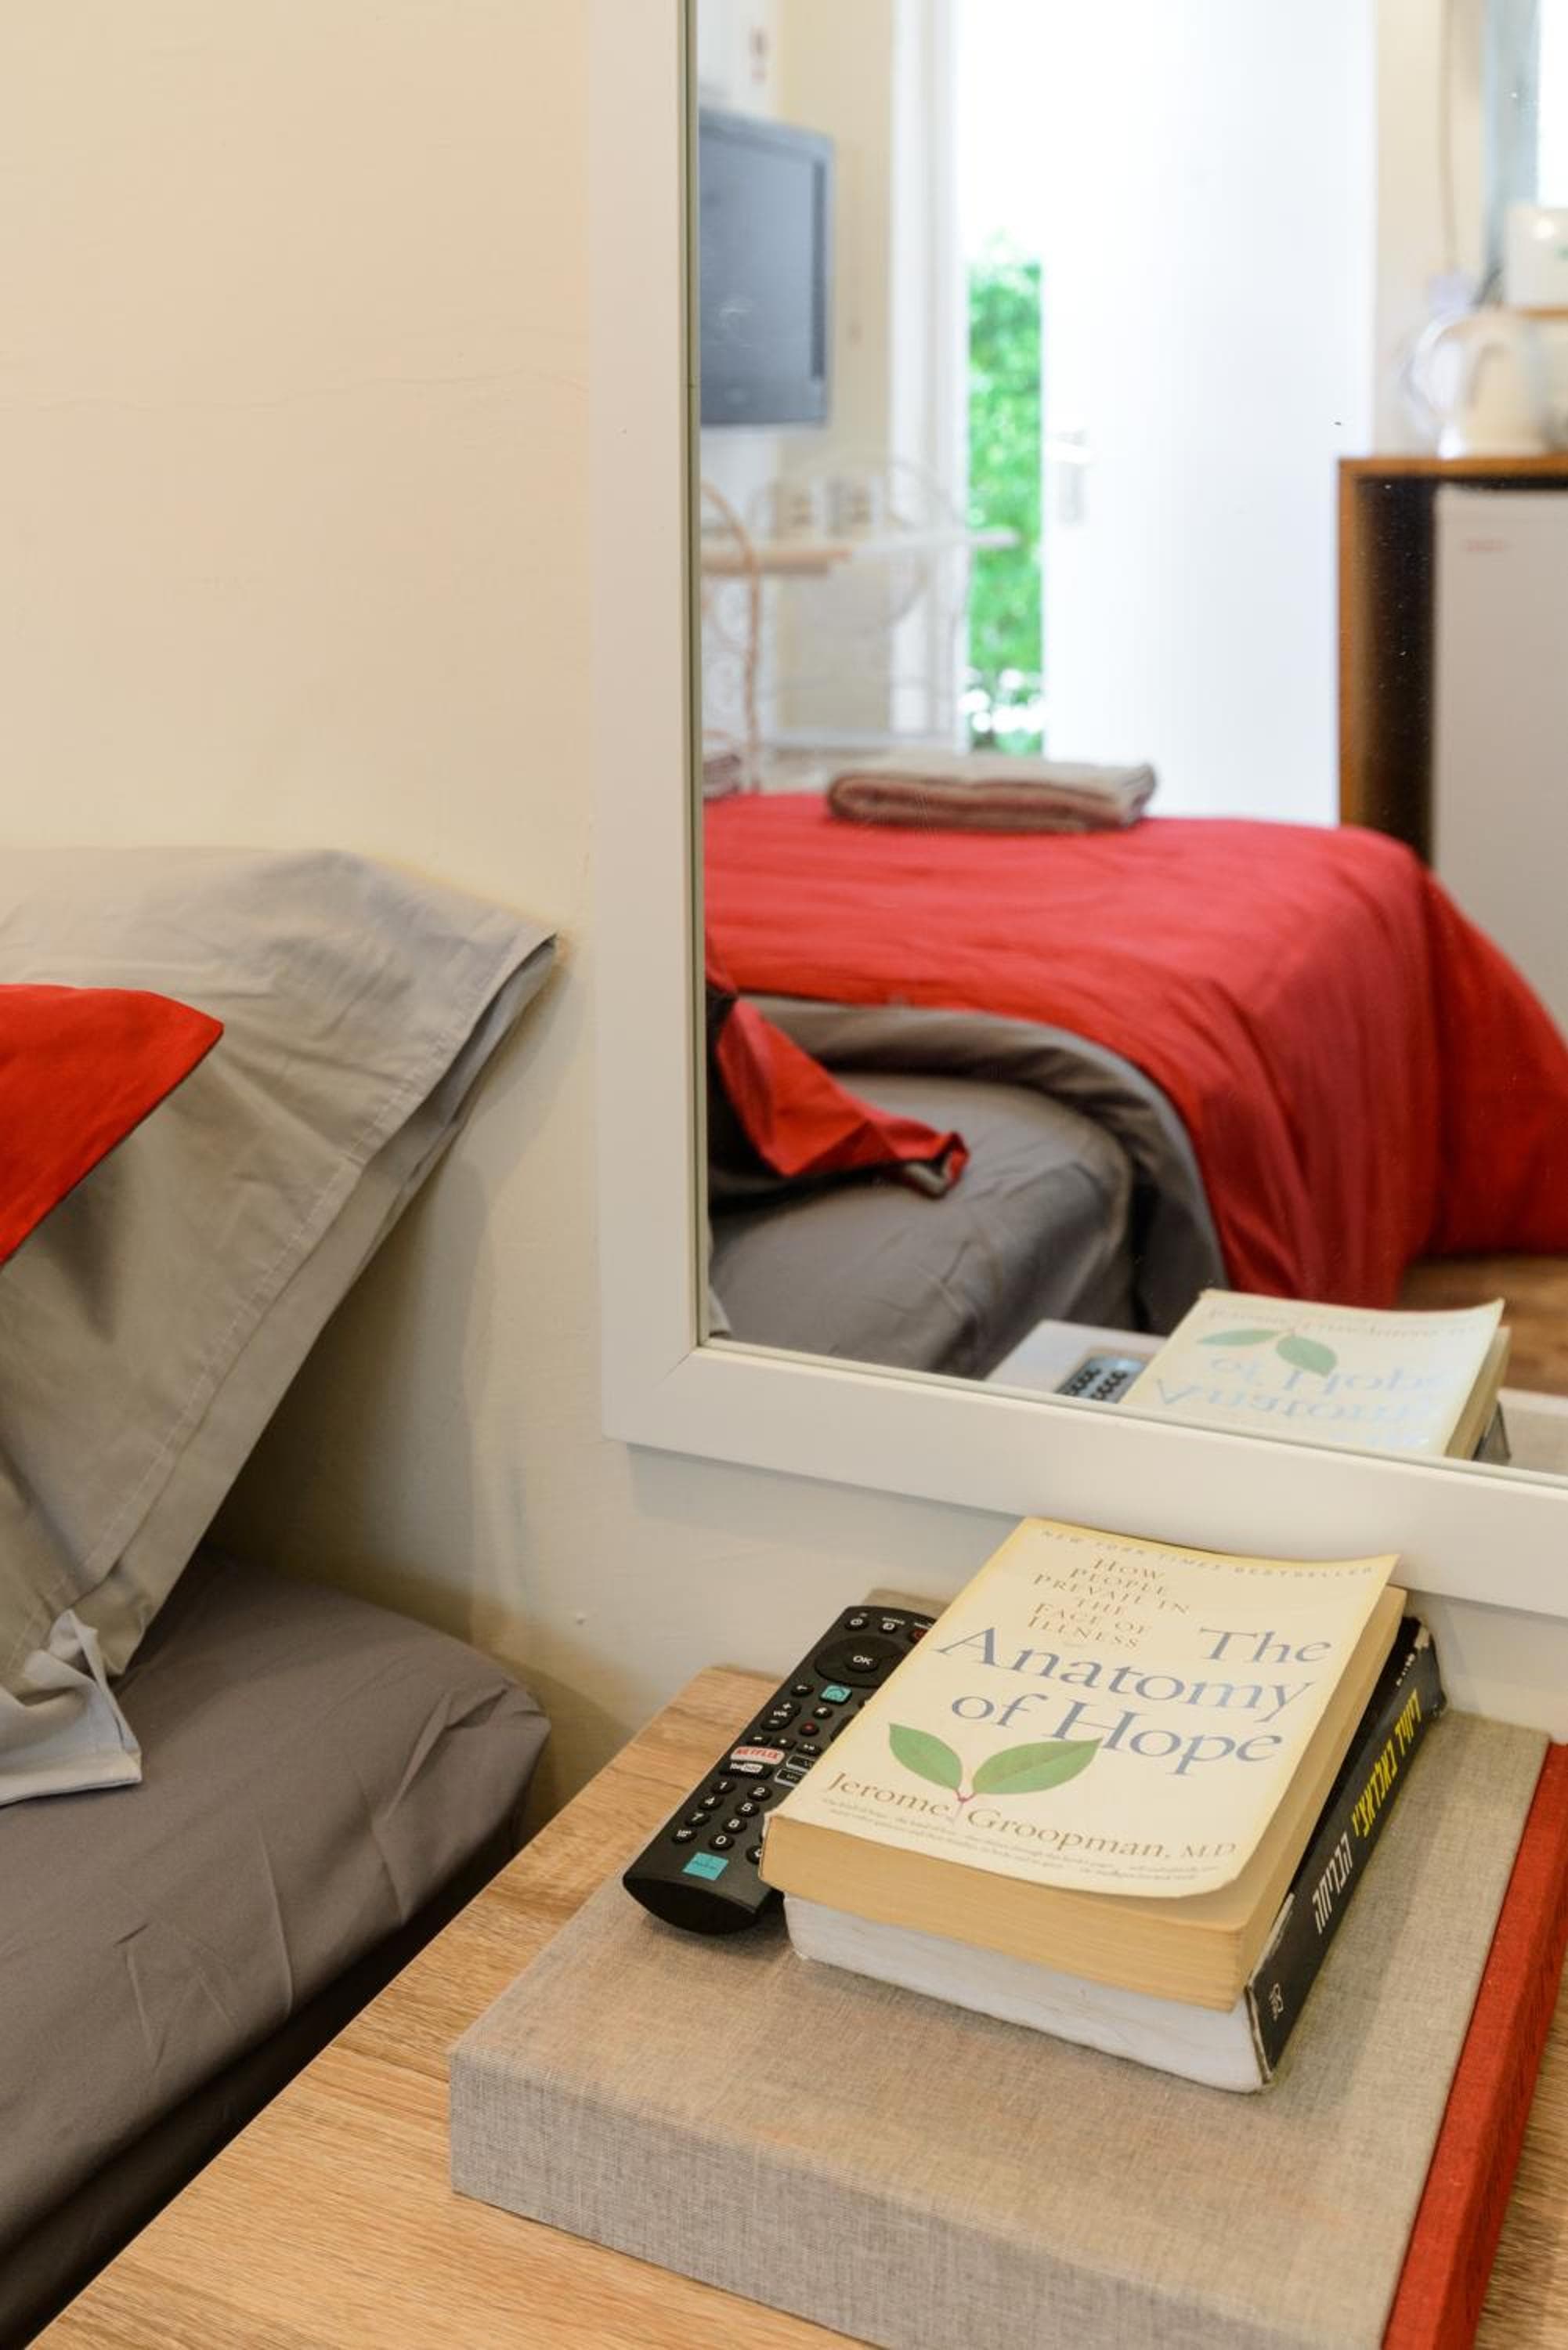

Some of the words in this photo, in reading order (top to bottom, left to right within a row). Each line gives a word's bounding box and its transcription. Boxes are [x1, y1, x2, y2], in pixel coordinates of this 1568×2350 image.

[1071, 1568, 1166, 1595] PEOPLE
[1093, 1559, 1165, 1579] HOW
[1034, 1574, 1143, 1603] PREVAIL
[1159, 1600, 1190, 1614] IN
[1075, 1598, 1123, 1615] THE
[1028, 1616, 1138, 1647] ILLNESS
[1035, 1603, 1098, 1624] FACE
[1115, 1623, 1145, 1634] OF
[1199, 1627, 1332, 1664] The
[853, 1655, 873, 1665] OK
[935, 1627, 1316, 1723] Anatomy
[951, 1693, 1049, 1727] of
[1041, 1699, 1283, 1776] Hope
[736, 1747, 779, 1760] NETFLIX
[720, 1781, 728, 1790] 1
[753, 1787, 766, 1796] 2
[705, 1796, 715, 1805] 4
[742, 1802, 753, 1812] 5
[826, 1772, 951, 1817] Jerome
[965, 1806, 1169, 1861] Groopman,
[691, 1812, 704, 1821] 7
[728, 1818, 740, 1828] 8
[715, 1835, 727, 1845] 0
[1313, 1831, 1353, 1934] הבריחה
